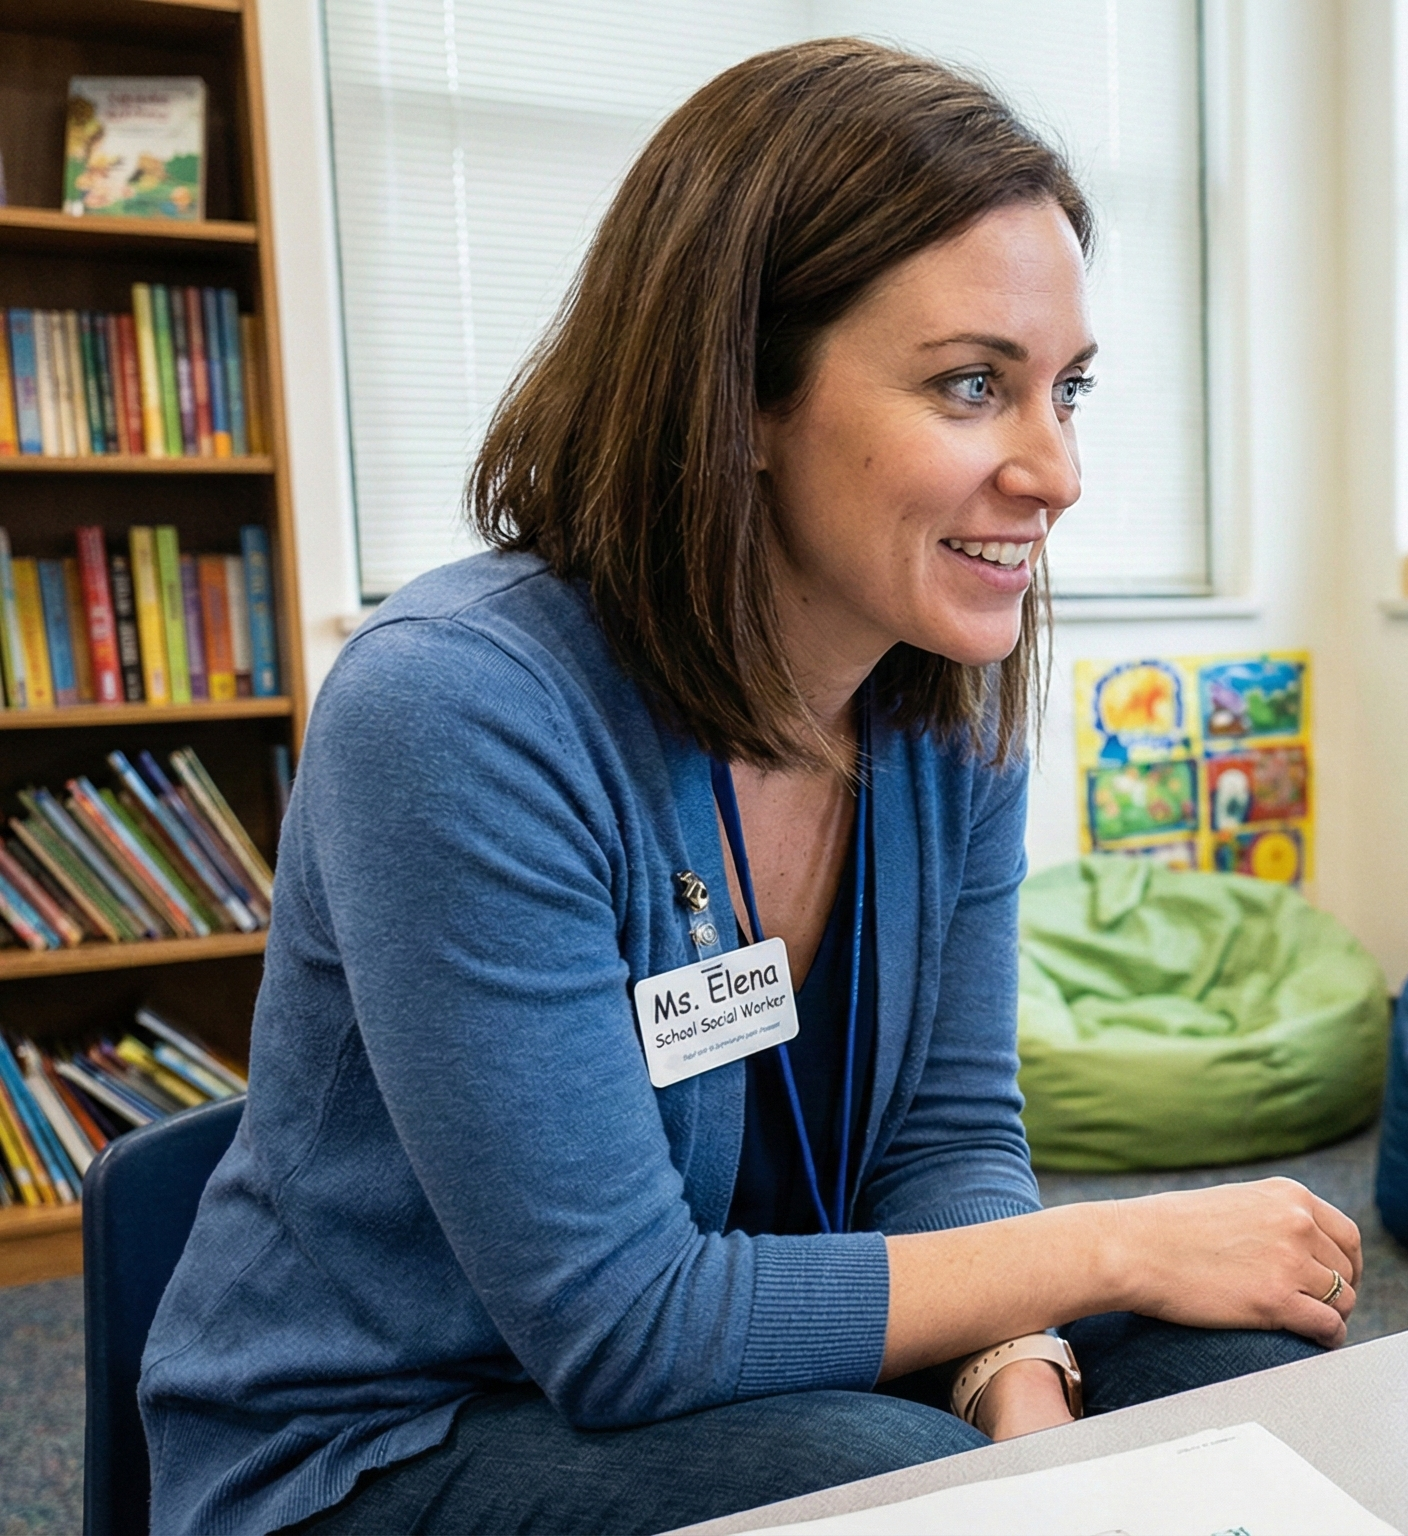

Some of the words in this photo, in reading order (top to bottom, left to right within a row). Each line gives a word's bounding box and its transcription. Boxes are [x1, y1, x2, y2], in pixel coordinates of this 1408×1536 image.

[654, 990, 699, 1024] Ms.
[707, 964, 778, 1003] Elena
[656, 1022, 697, 1048] School
[701, 1007, 738, 1032] Social
[740, 994, 786, 1018] Worker
